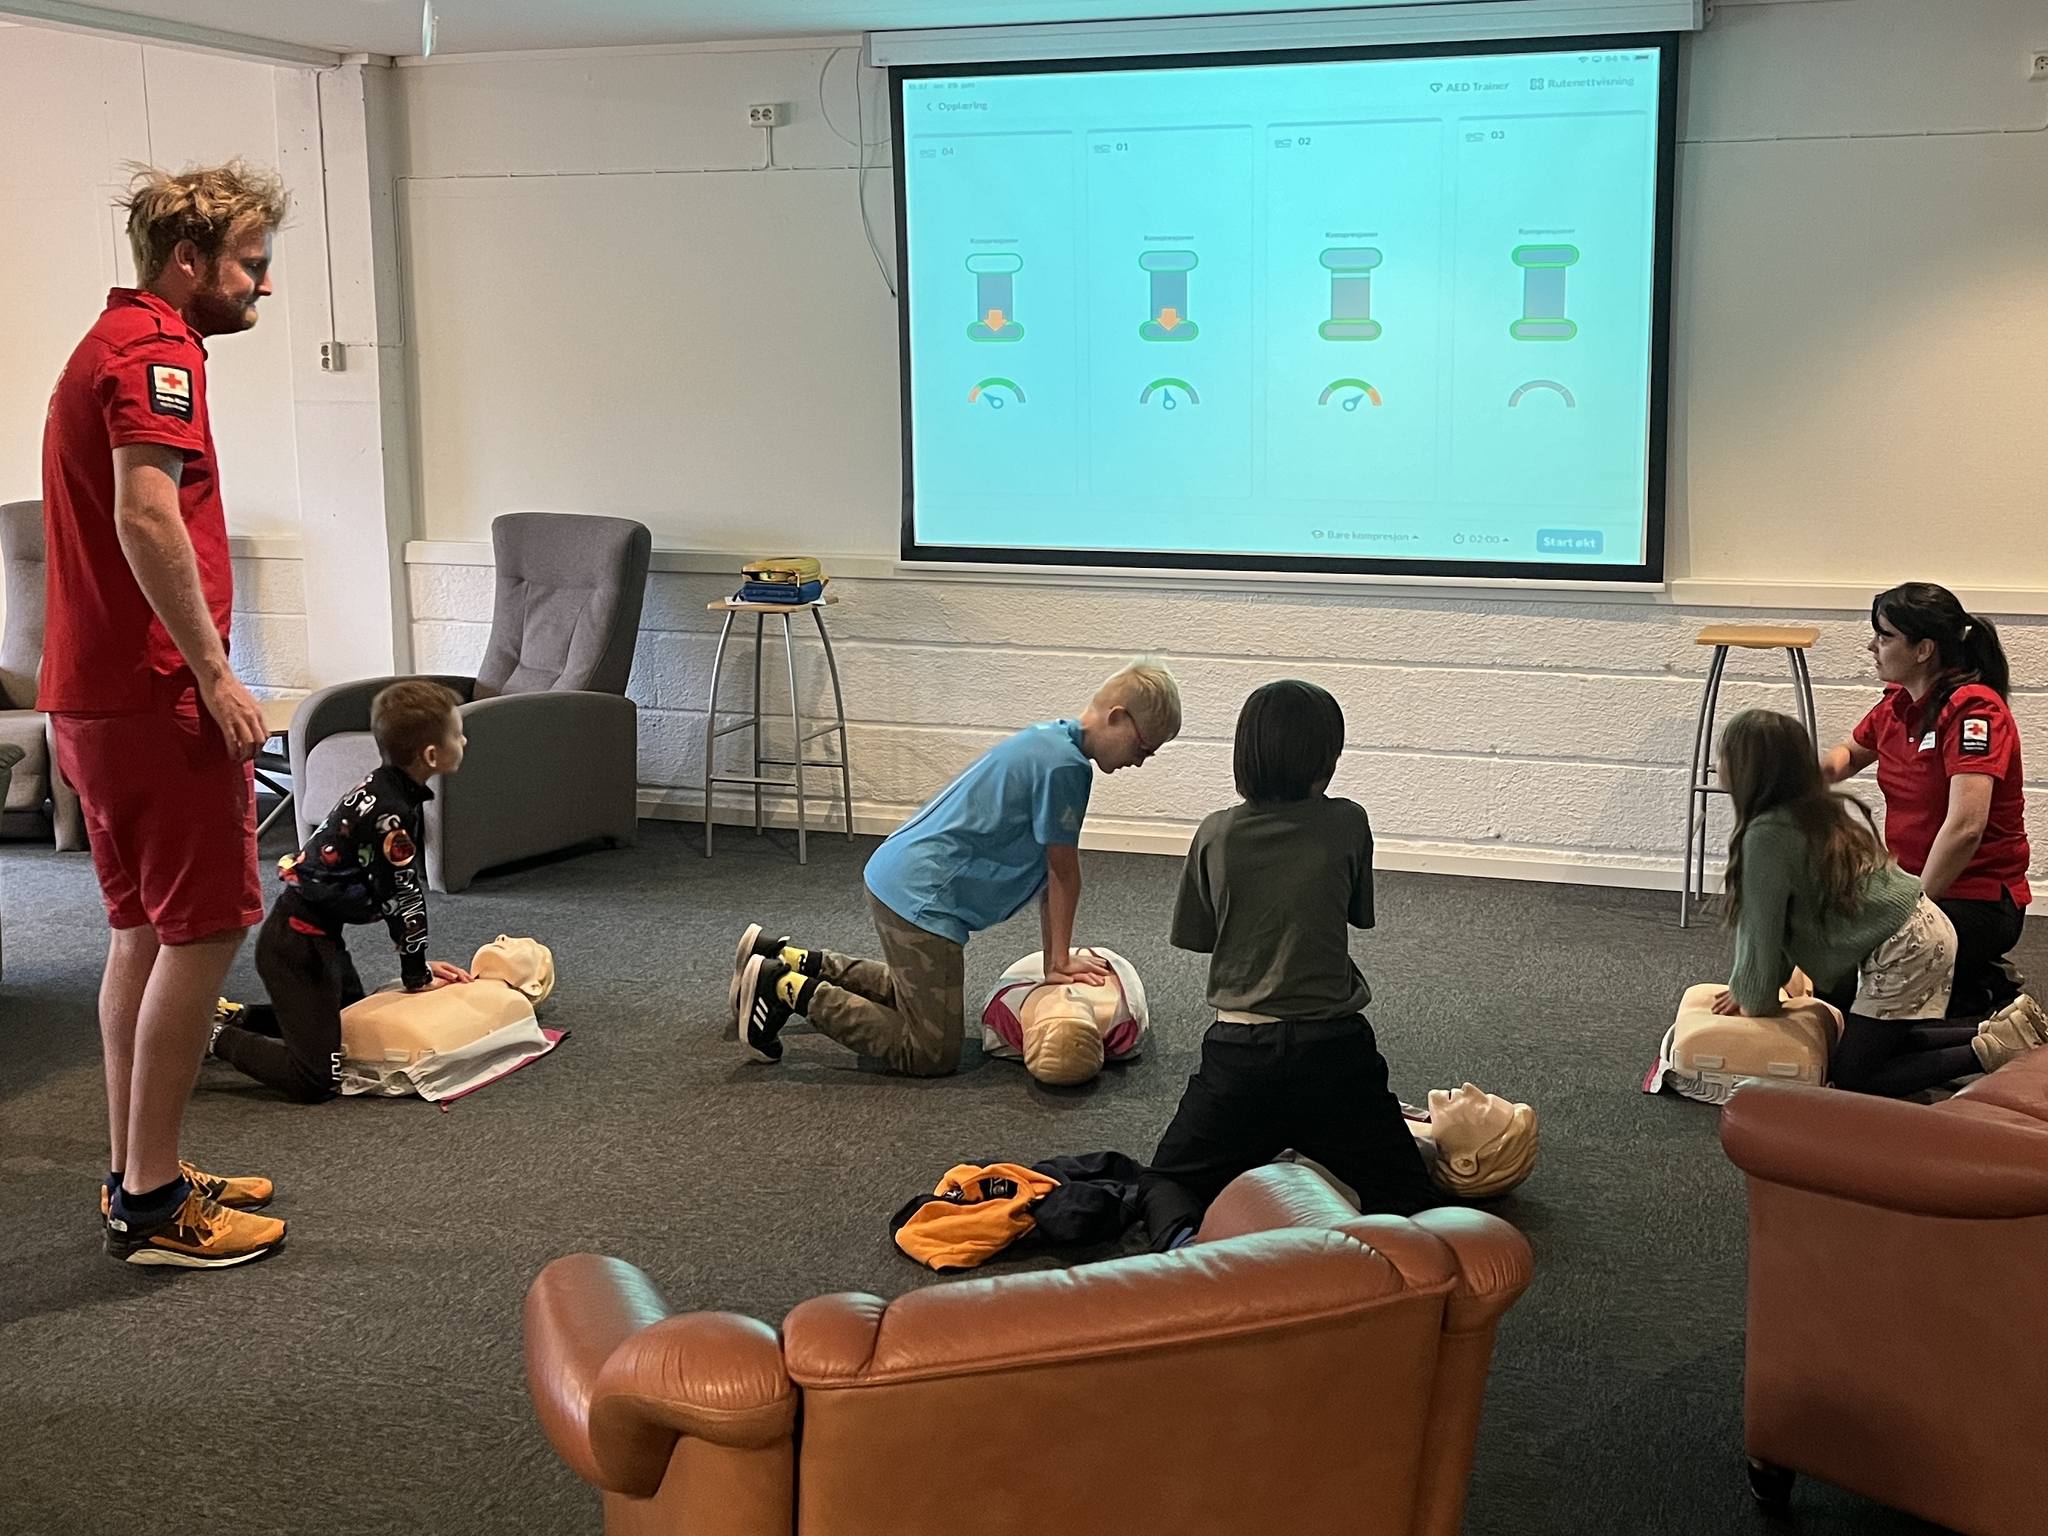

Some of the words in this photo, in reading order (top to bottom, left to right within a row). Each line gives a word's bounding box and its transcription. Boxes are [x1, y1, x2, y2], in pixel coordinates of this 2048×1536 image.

[1446, 82, 1470, 93] AED
[1473, 81, 1509, 92] Trainer
[1491, 131, 1505, 140] 03
[1298, 137, 1311, 146] 02
[1116, 143, 1128, 152] 01
[1543, 536, 1573, 548] Start
